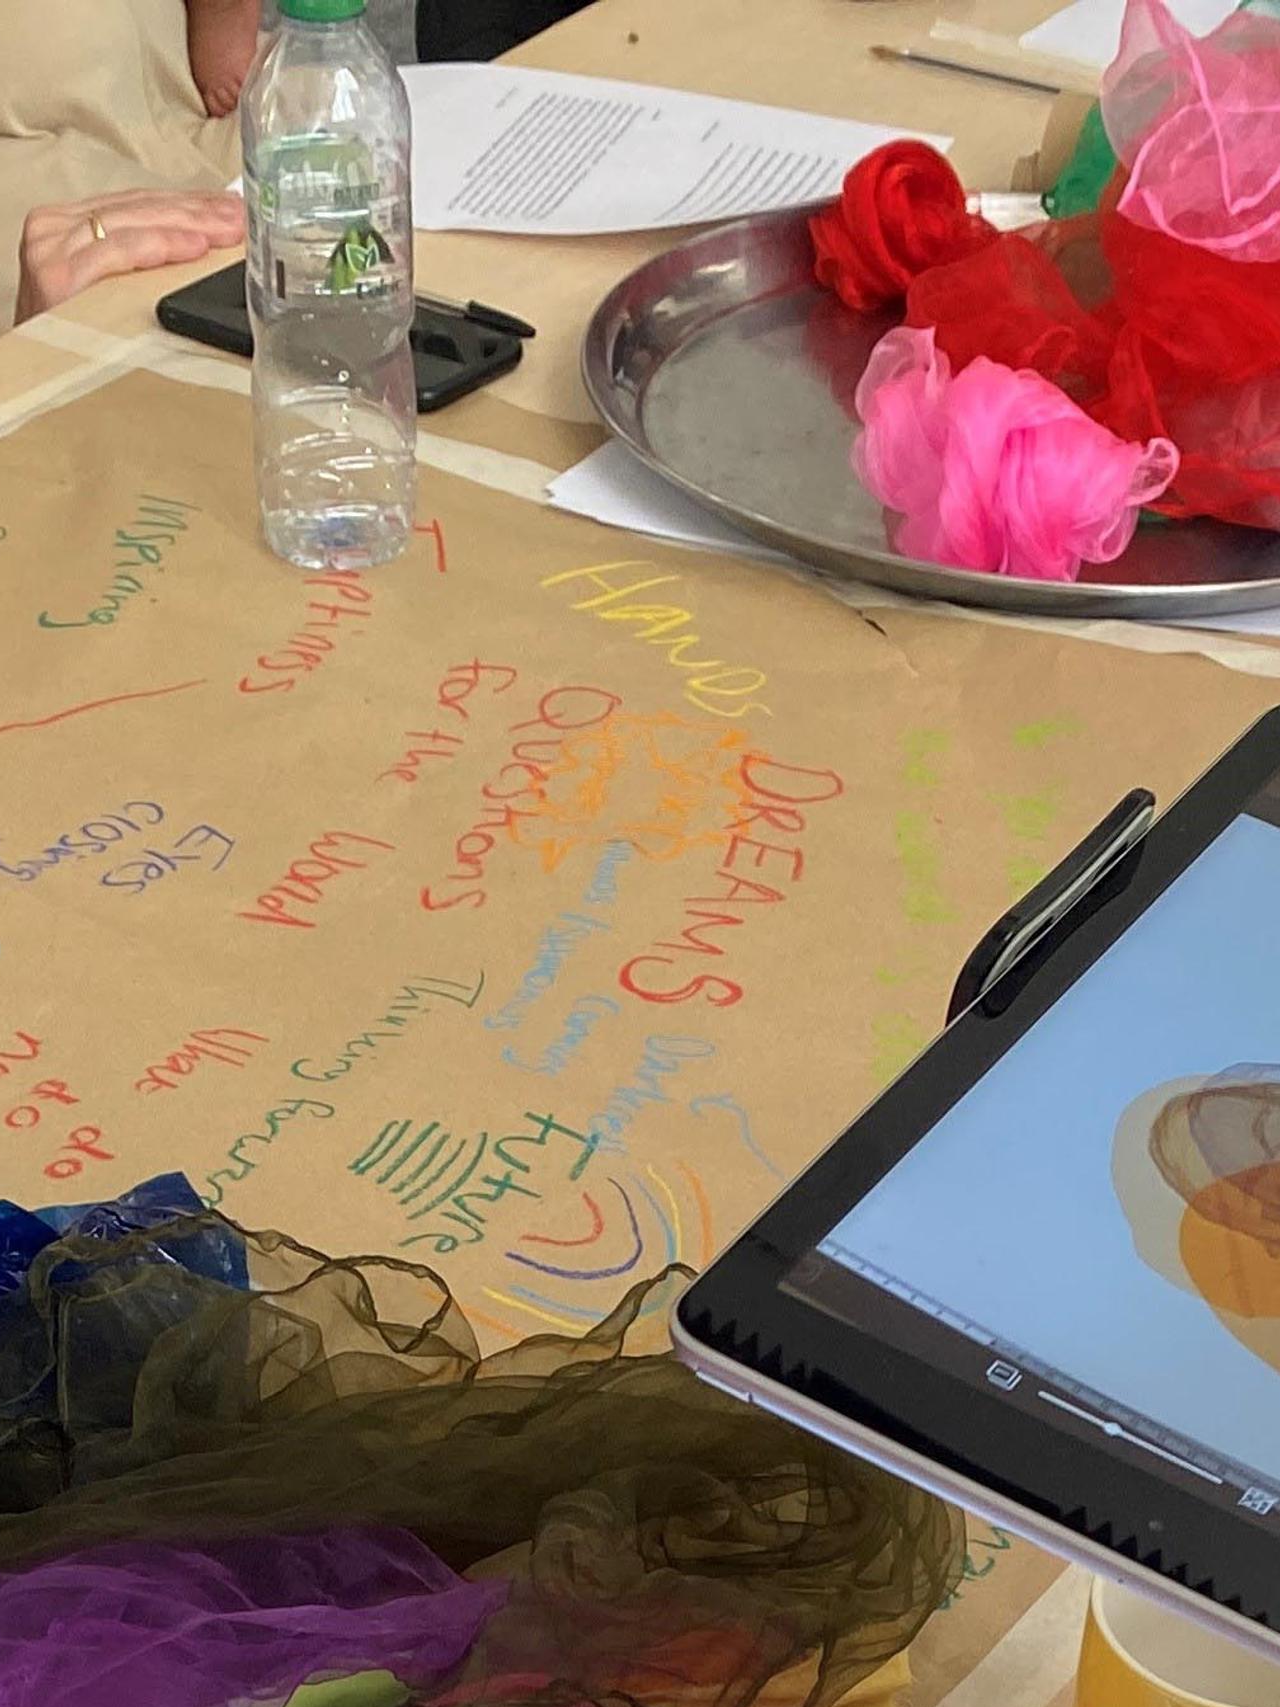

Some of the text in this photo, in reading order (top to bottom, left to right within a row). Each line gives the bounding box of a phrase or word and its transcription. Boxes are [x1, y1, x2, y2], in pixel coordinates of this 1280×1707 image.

[434, 656, 518, 719] for
[374, 727, 465, 788] the
[618, 752, 845, 1007] DREAMS
[397, 1110, 601, 1253] Future
